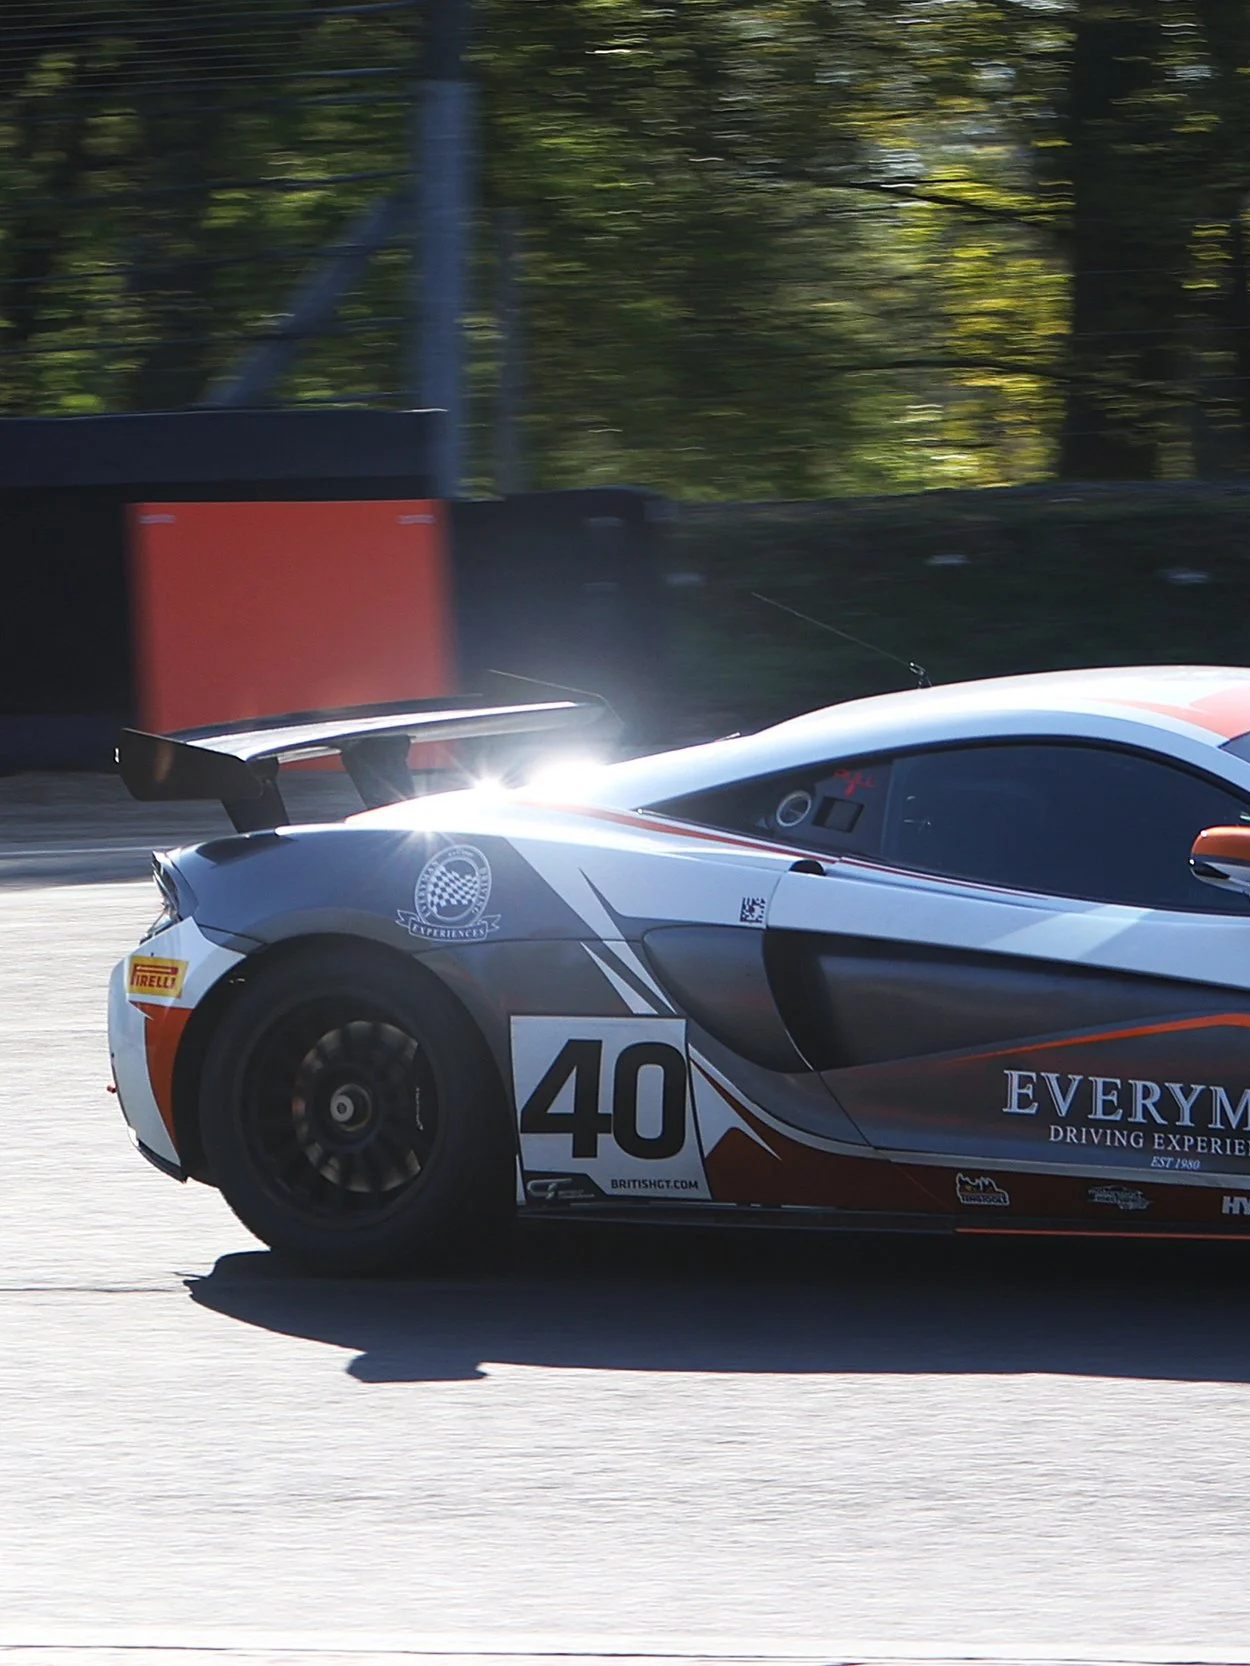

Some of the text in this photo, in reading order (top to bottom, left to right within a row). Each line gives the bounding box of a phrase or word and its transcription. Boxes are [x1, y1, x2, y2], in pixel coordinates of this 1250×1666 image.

[411, 923, 486, 939] EXPERIENCES
[130, 963, 179, 989] PIRELLI
[520, 1038, 687, 1160] 40
[1050, 1124, 1144, 1149] DRIVING
[1151, 1155, 1200, 1170] EST 1980
[611, 1179, 699, 1190] BRITISHGT.COM
